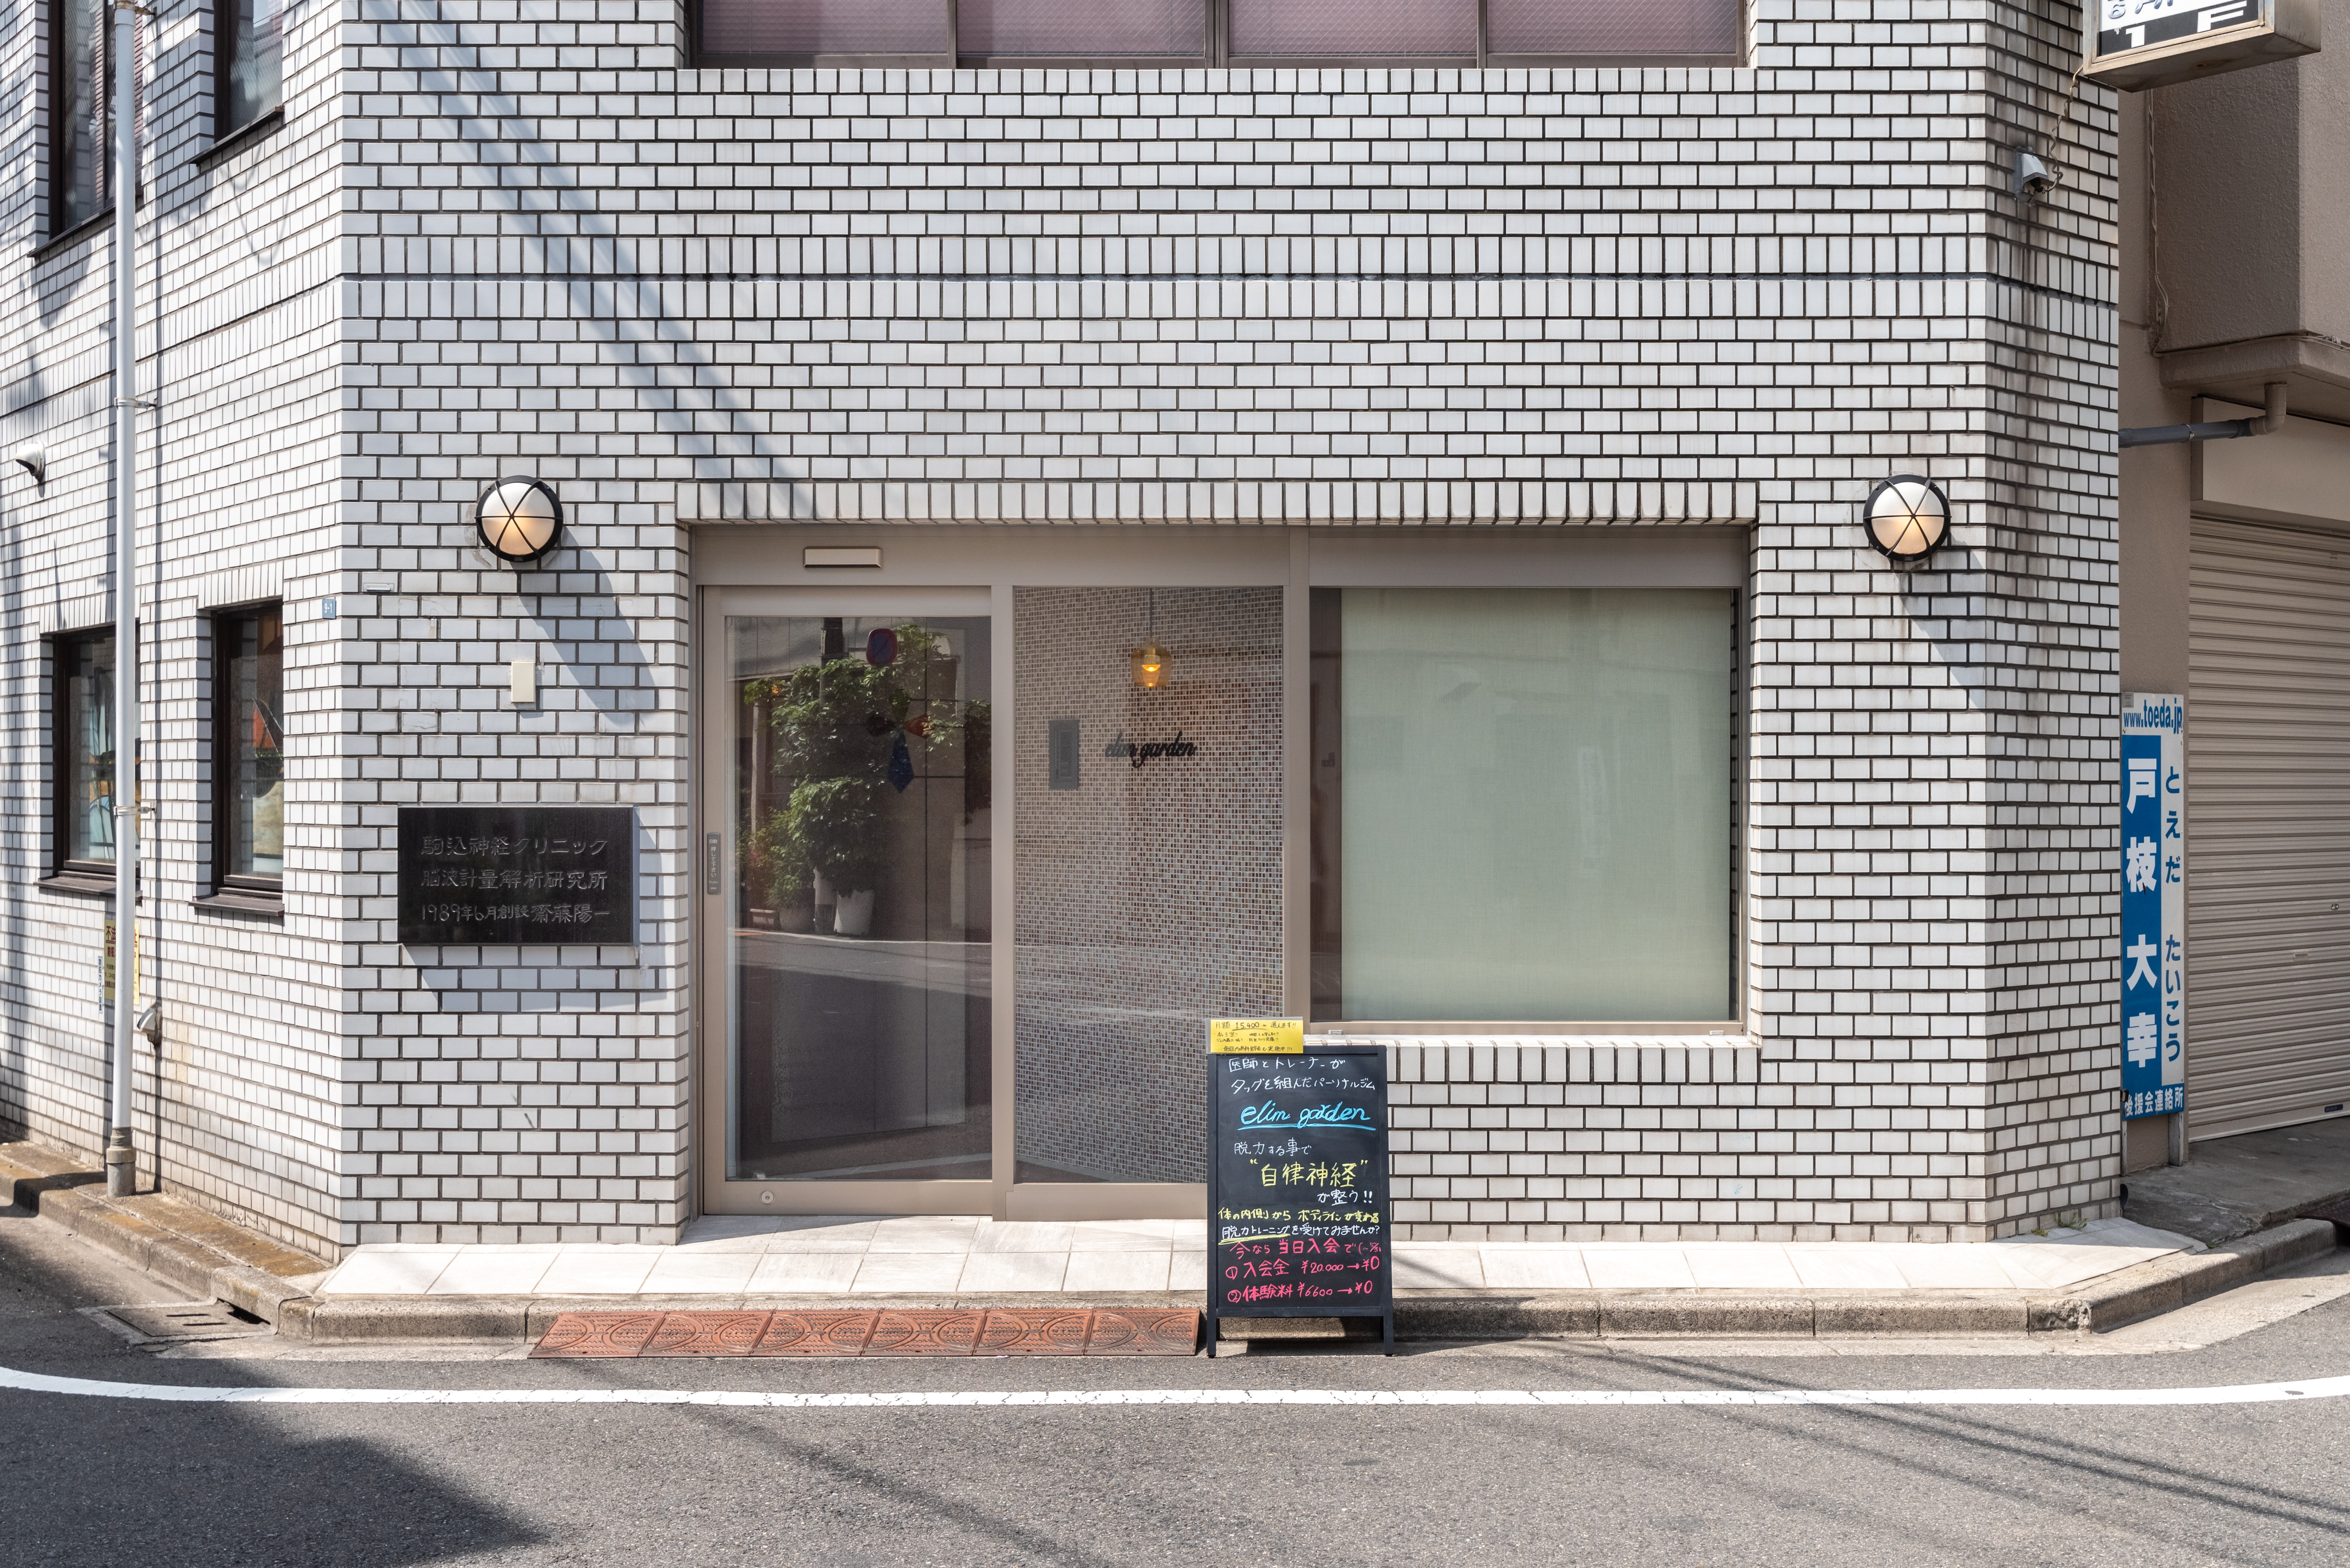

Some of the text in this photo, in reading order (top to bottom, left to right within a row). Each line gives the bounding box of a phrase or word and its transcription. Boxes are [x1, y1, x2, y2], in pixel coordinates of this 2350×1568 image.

[2123, 698, 2183, 734] www.toeda.jp
[421, 836, 608, 856] 駒込神経クリニック
[421, 868, 608, 890] 脳波計量解析研究所
[1231, 1076, 1376, 1094] タッグを組んだパーソナルジム
[2124, 1087, 2183, 1117] 後援会連絡所
[1240, 1100, 1371, 1129] elim garden
[1234, 1137, 1312, 1157] 脱力する事で
